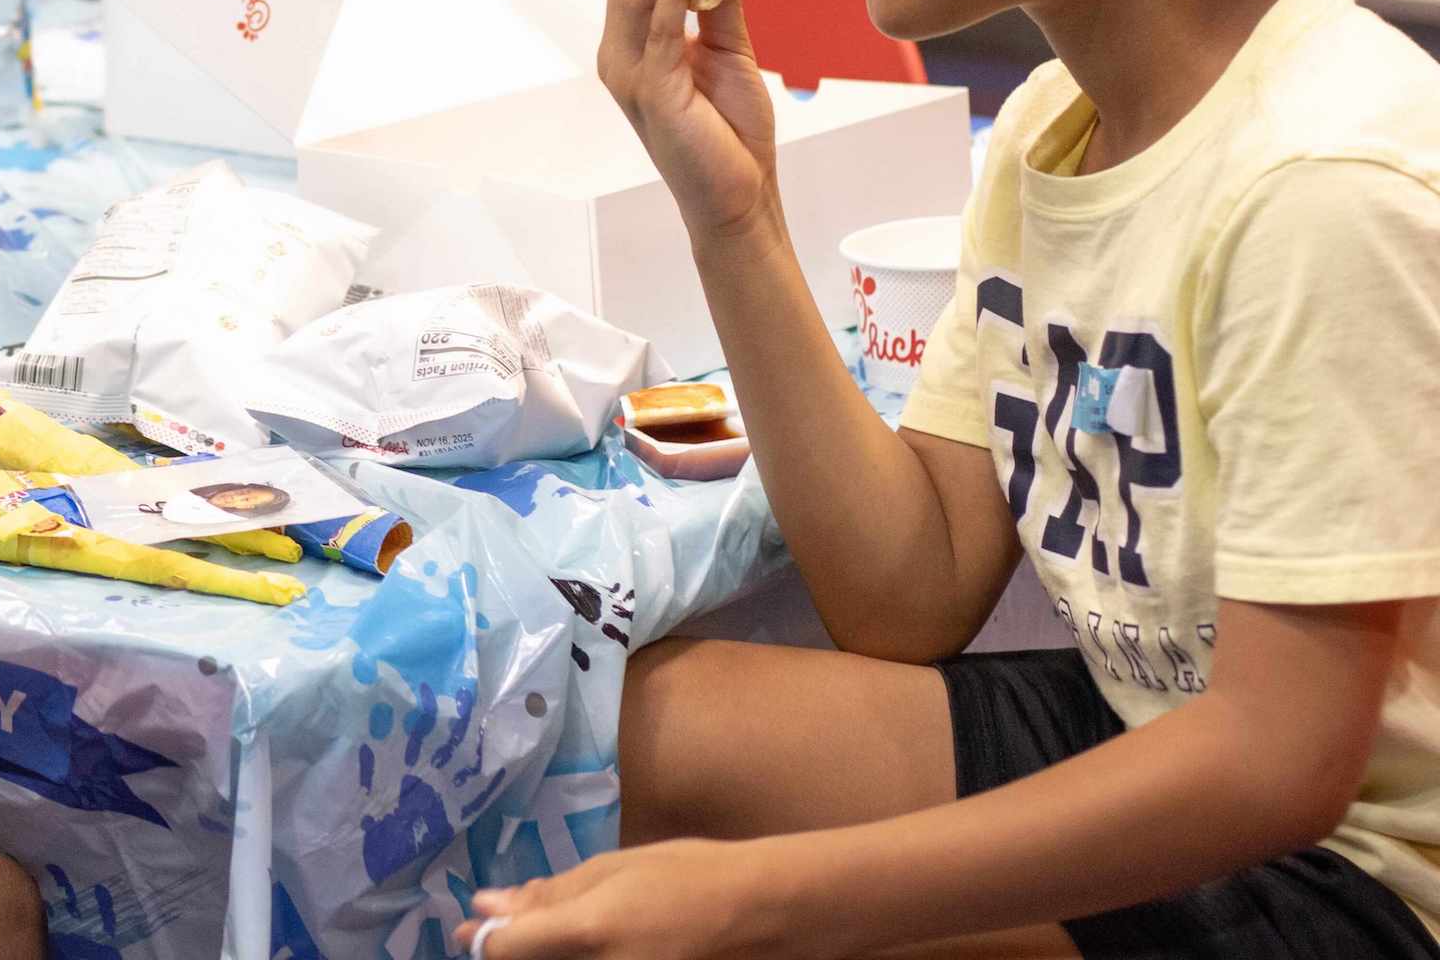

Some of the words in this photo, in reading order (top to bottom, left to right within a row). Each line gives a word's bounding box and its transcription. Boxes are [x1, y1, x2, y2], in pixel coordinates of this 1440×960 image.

[421, 333, 452, 344] 220
[417, 365, 447, 377] Facts
[451, 362, 507, 380] Nutrition
[416, 438, 435, 448] NOV
[453, 432, 474, 445] 2025
